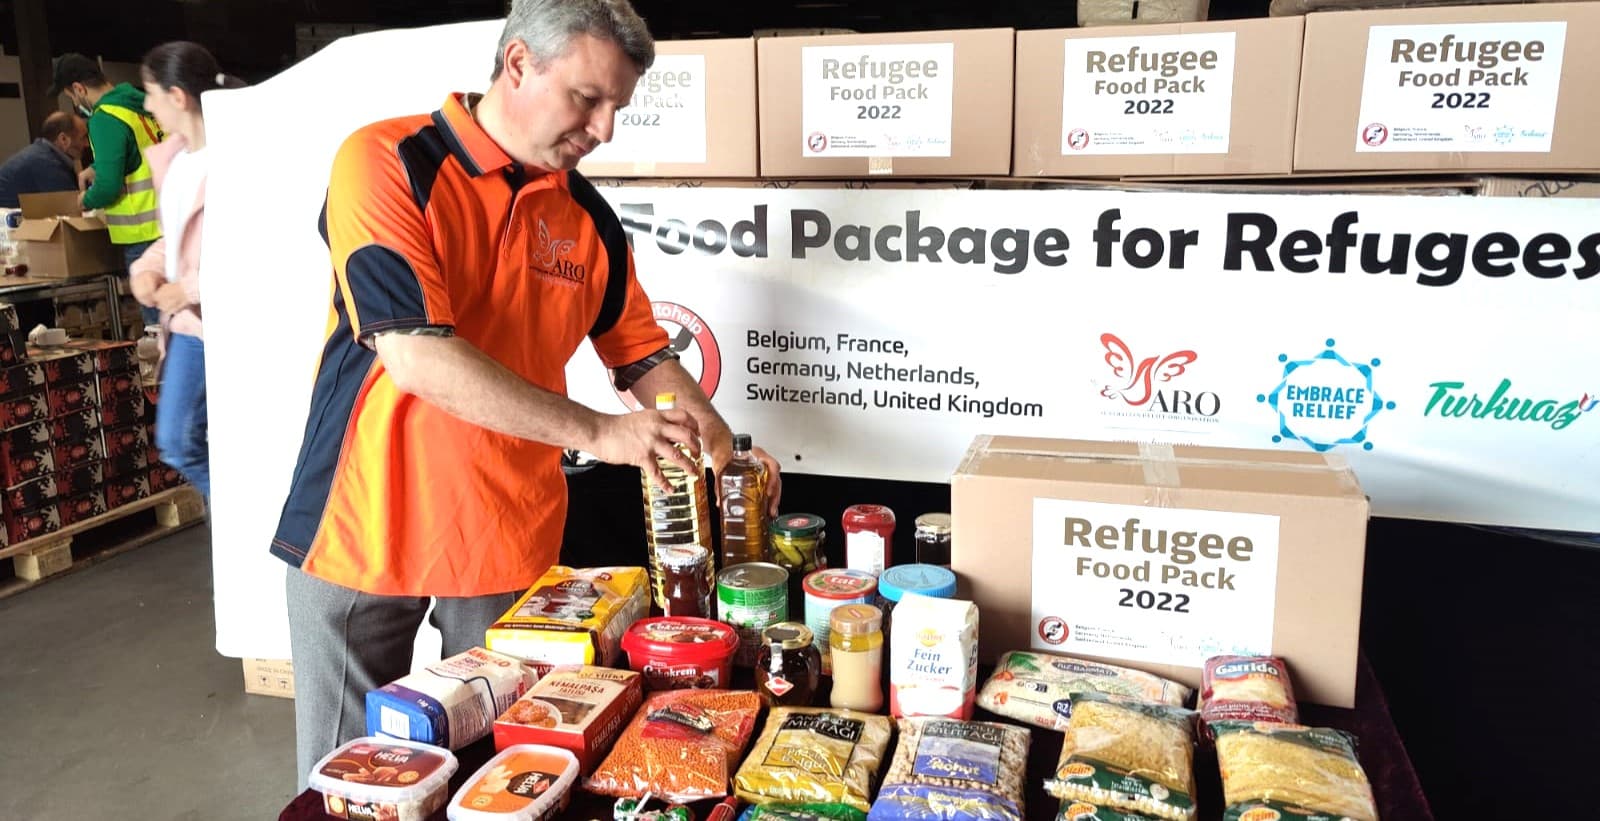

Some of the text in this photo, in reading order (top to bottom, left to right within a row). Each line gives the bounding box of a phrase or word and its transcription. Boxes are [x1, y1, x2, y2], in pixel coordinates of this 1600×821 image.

[1086, 46, 1218, 77] Refugee
[1390, 34, 1545, 69] Refugee
[822, 55, 938, 84] Refugee
[1399, 67, 1529, 87] Food Pack
[636, 70, 692, 93] ugee
[830, 83, 928, 100] Food Pack
[1094, 75, 1205, 95] Food Pack
[1124, 99, 1174, 115] 2022
[1431, 92, 1491, 109] 2022
[622, 113, 661, 126] 2022
[857, 105, 902, 119] 2022
[620, 203, 1600, 287] Food Package for Refugees
[746, 330, 909, 358] Belgium, France,
[746, 357, 980, 389] Germany, Netherlands,
[746, 383, 1043, 418] Switzerland, United Kingdom
[1286, 385, 1364, 404] EMBRACE
[1424, 378, 1582, 430] Turkuaz
[1292, 403, 1357, 420] RELIEF
[1064, 516, 1254, 565] Refugee
[1076, 557, 1236, 591] Food Pack
[1118, 588, 1190, 613] 2022
[914, 648, 941, 661] Fein
[907, 660, 952, 675] Zucker
[1215, 663, 1278, 676] Garrido
